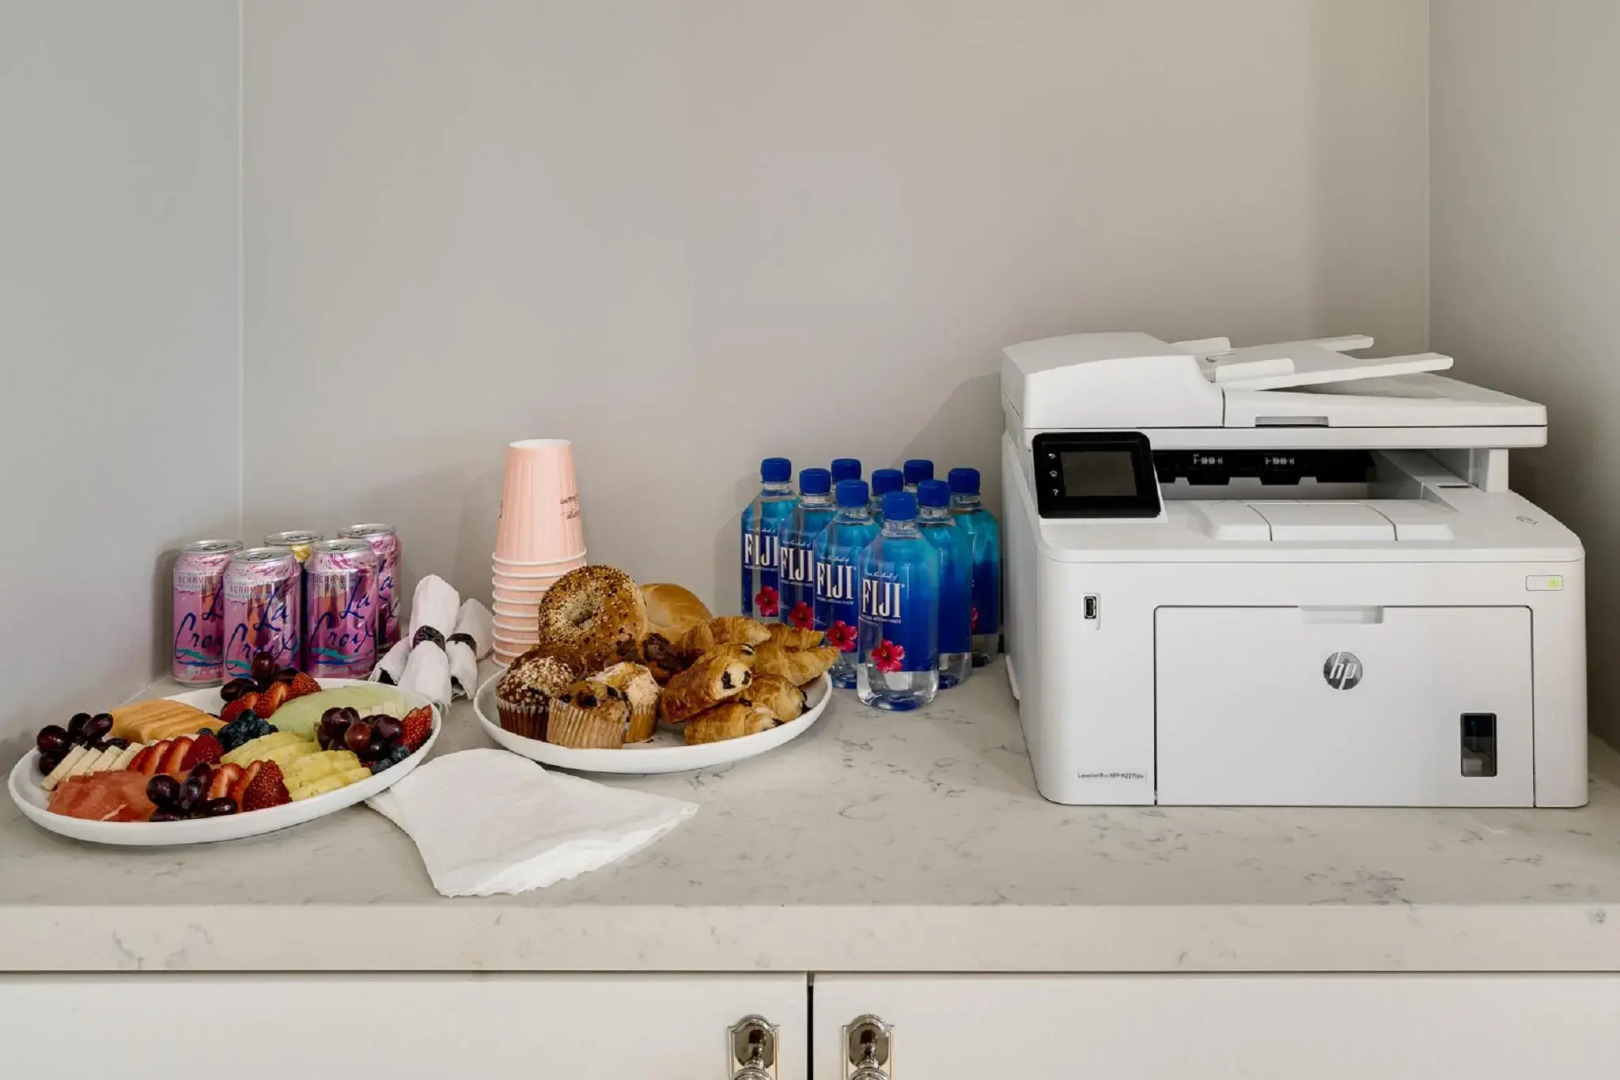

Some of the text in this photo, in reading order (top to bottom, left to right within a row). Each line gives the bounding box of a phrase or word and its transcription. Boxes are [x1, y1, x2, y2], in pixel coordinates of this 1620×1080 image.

[744, 533, 778, 567] FIJI
[780, 546, 813, 582] FIJI
[338, 569, 371, 619] La
[816, 561, 853, 600] FIJI
[862, 578, 901, 618] FIJI
[253, 586, 288, 632] La
[1329, 651, 1357, 690] hp
